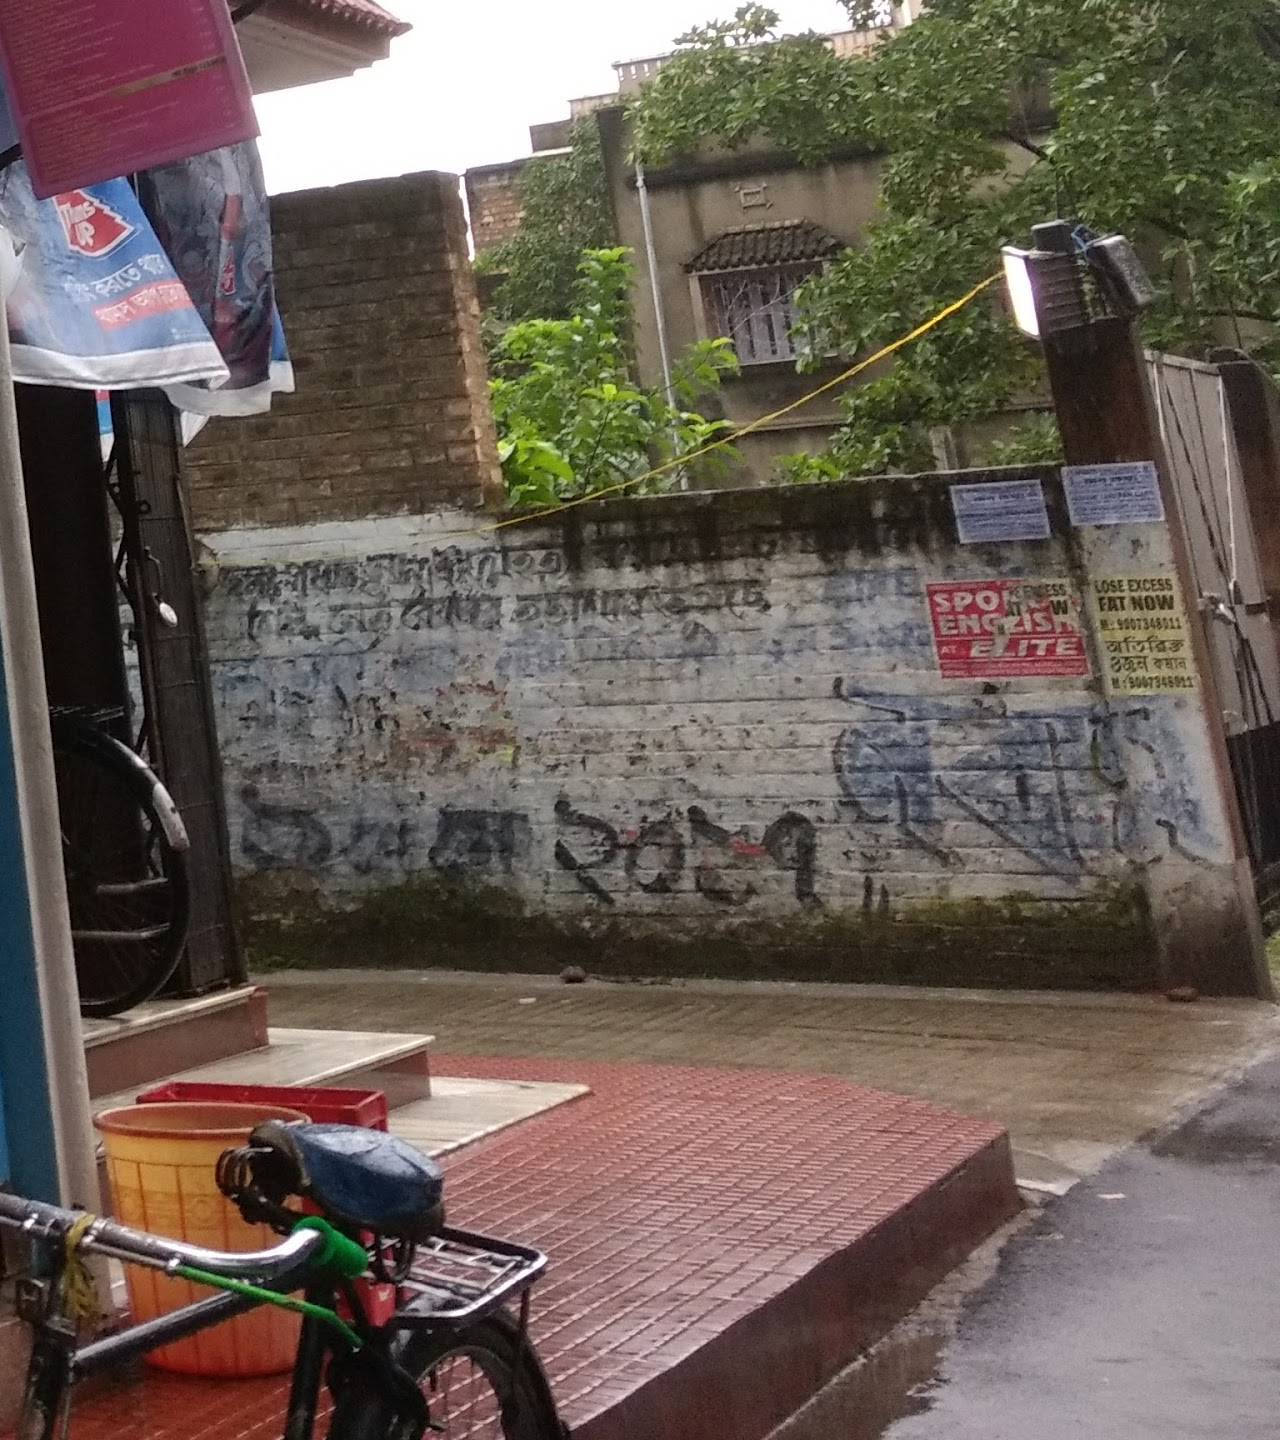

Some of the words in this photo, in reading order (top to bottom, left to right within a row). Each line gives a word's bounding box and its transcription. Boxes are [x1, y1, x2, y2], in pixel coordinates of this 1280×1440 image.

[1094, 579, 1126, 594] LOSE
[1127, 578, 1174, 593] EXCESS
[1098, 595, 1126, 612] FAT
[1130, 594, 1175, 611] NOW
[970, 638, 1079, 658] ELITE
